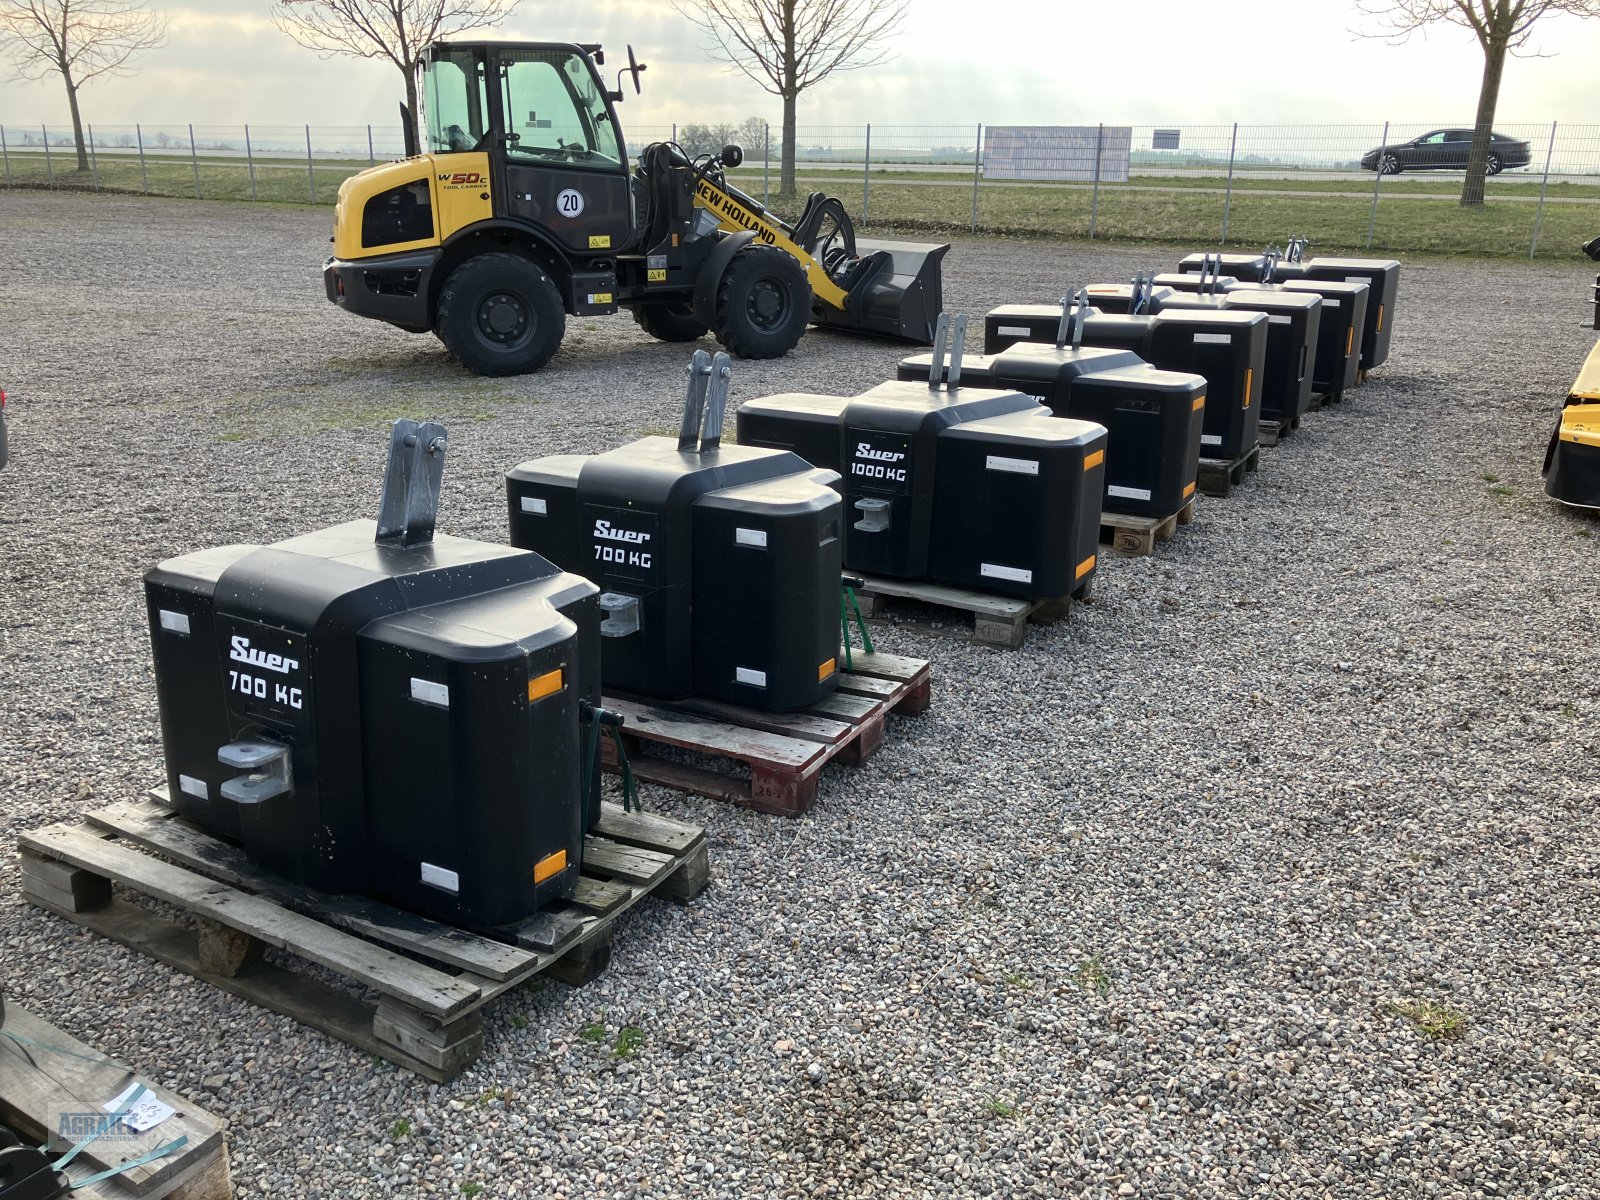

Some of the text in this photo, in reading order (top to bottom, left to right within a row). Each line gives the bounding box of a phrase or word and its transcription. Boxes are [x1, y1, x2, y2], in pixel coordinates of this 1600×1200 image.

[563, 194, 578, 211] 20
[721, 200, 776, 245] HOLLAND
[855, 442, 905, 462] Suer
[851, 462, 906, 482] 1000 KG
[593, 519, 651, 544] Suer
[594, 545, 651, 568] 700 KG
[229, 635, 299, 674] Suer
[229, 670, 302, 710] 700 KG
